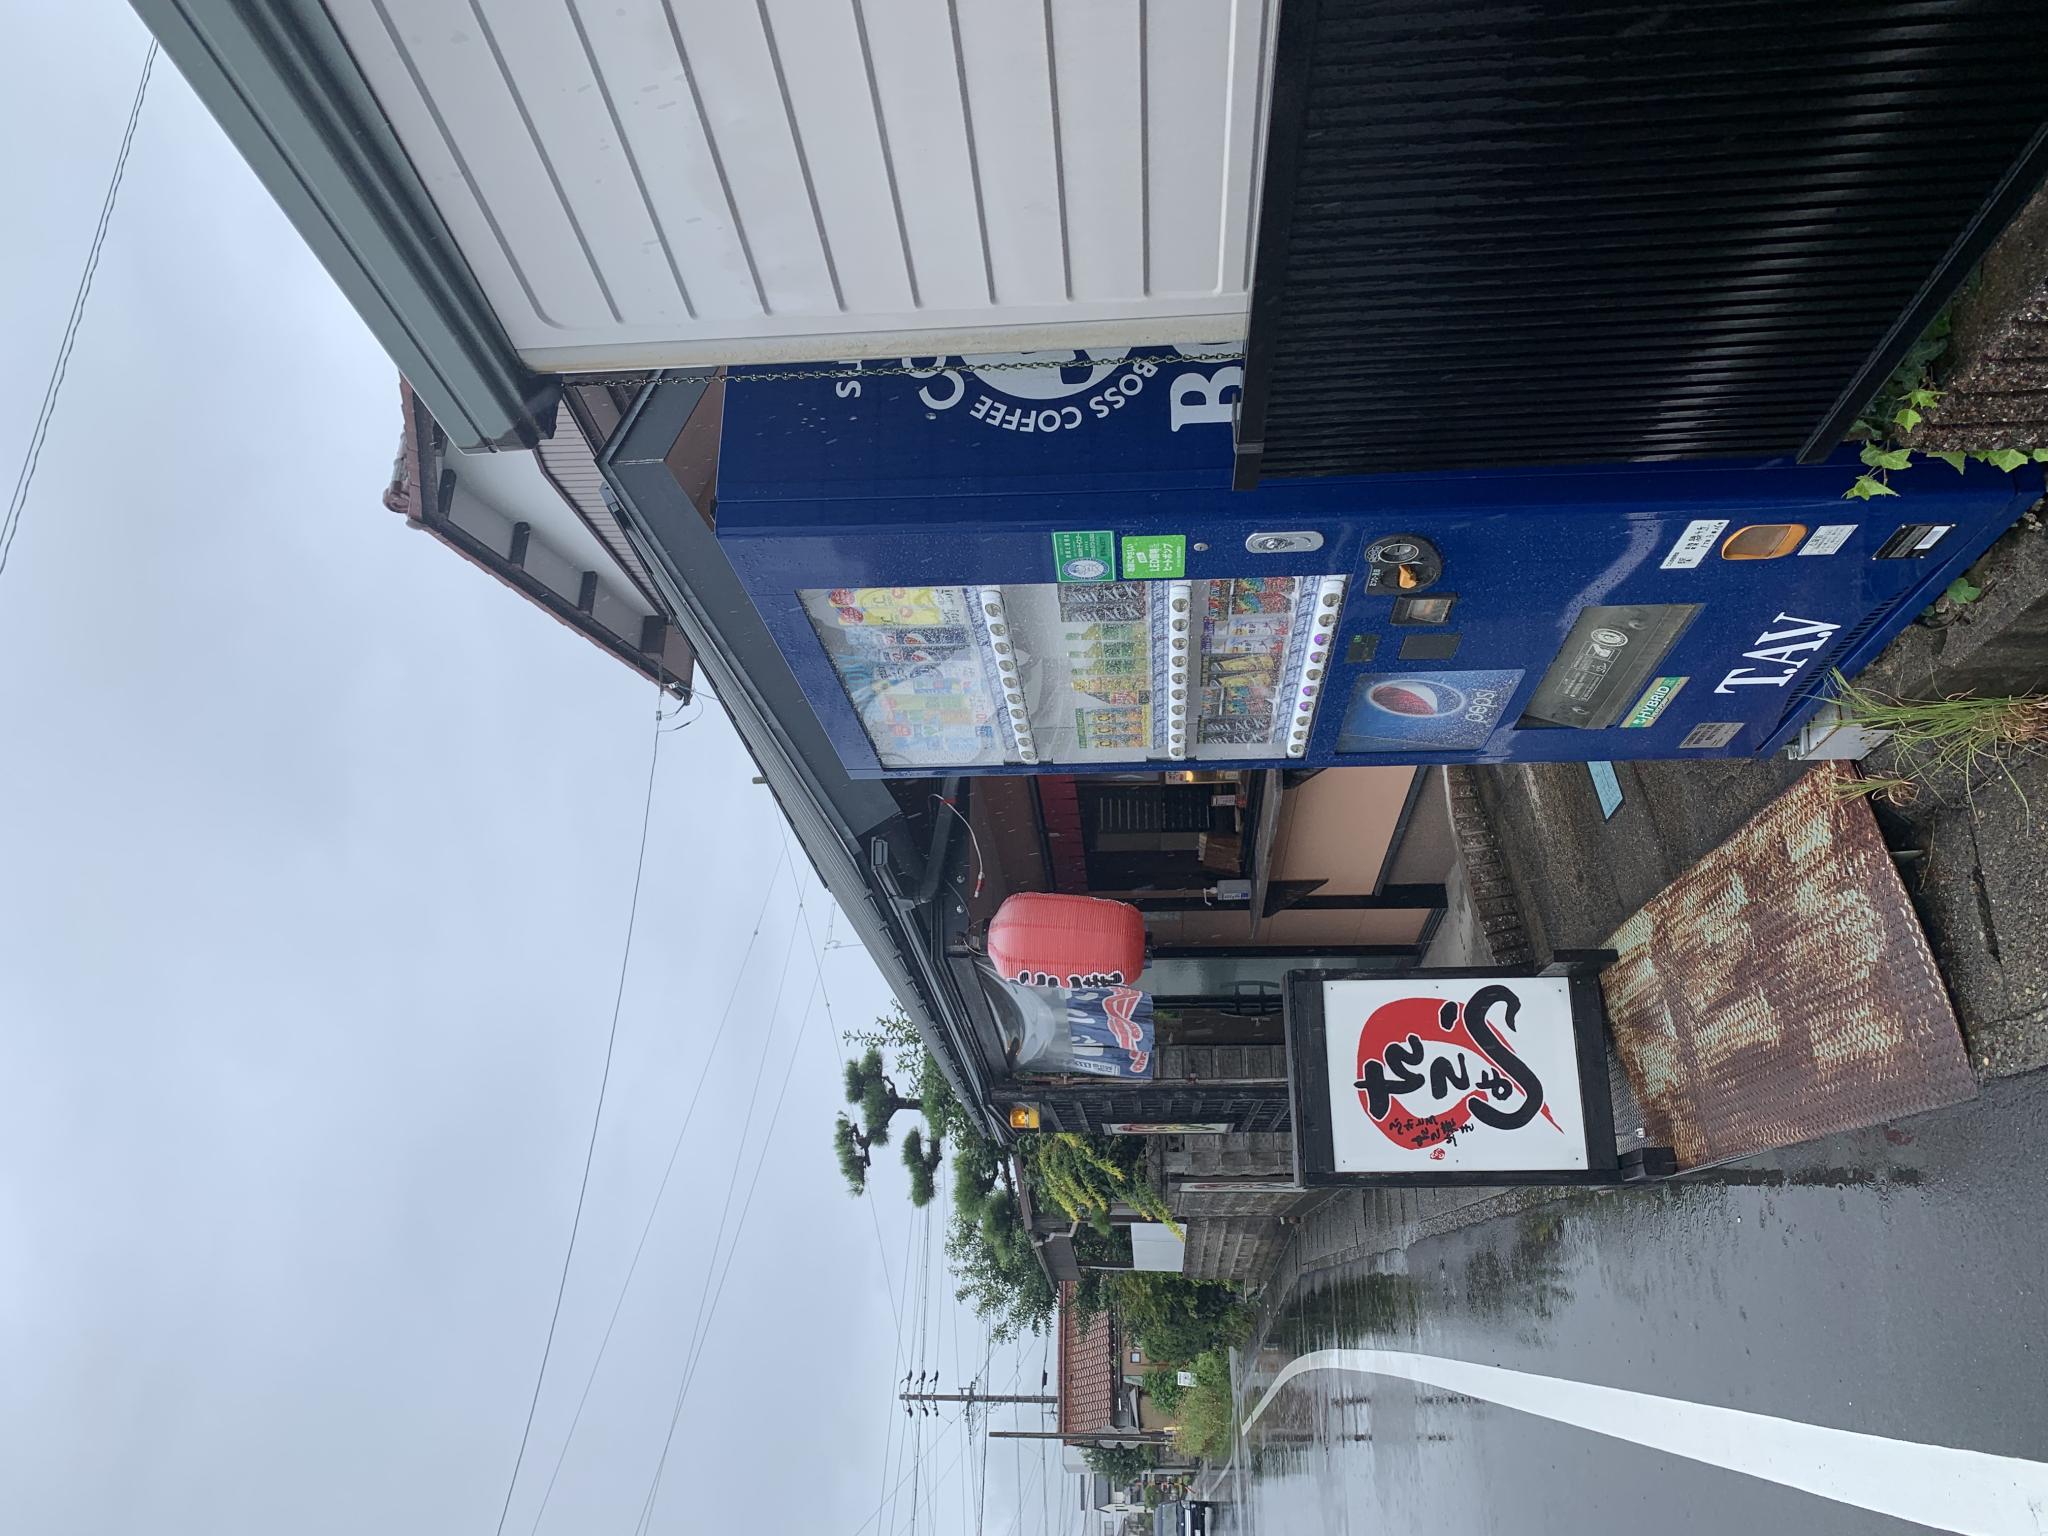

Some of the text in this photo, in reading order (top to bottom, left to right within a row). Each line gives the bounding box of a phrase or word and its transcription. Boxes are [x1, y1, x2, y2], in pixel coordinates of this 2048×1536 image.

[969, 360, 1159, 432] BOSS COFFEE
[1465, 688, 1497, 724] pepsi
[1637, 686, 1670, 719] HYBRID
